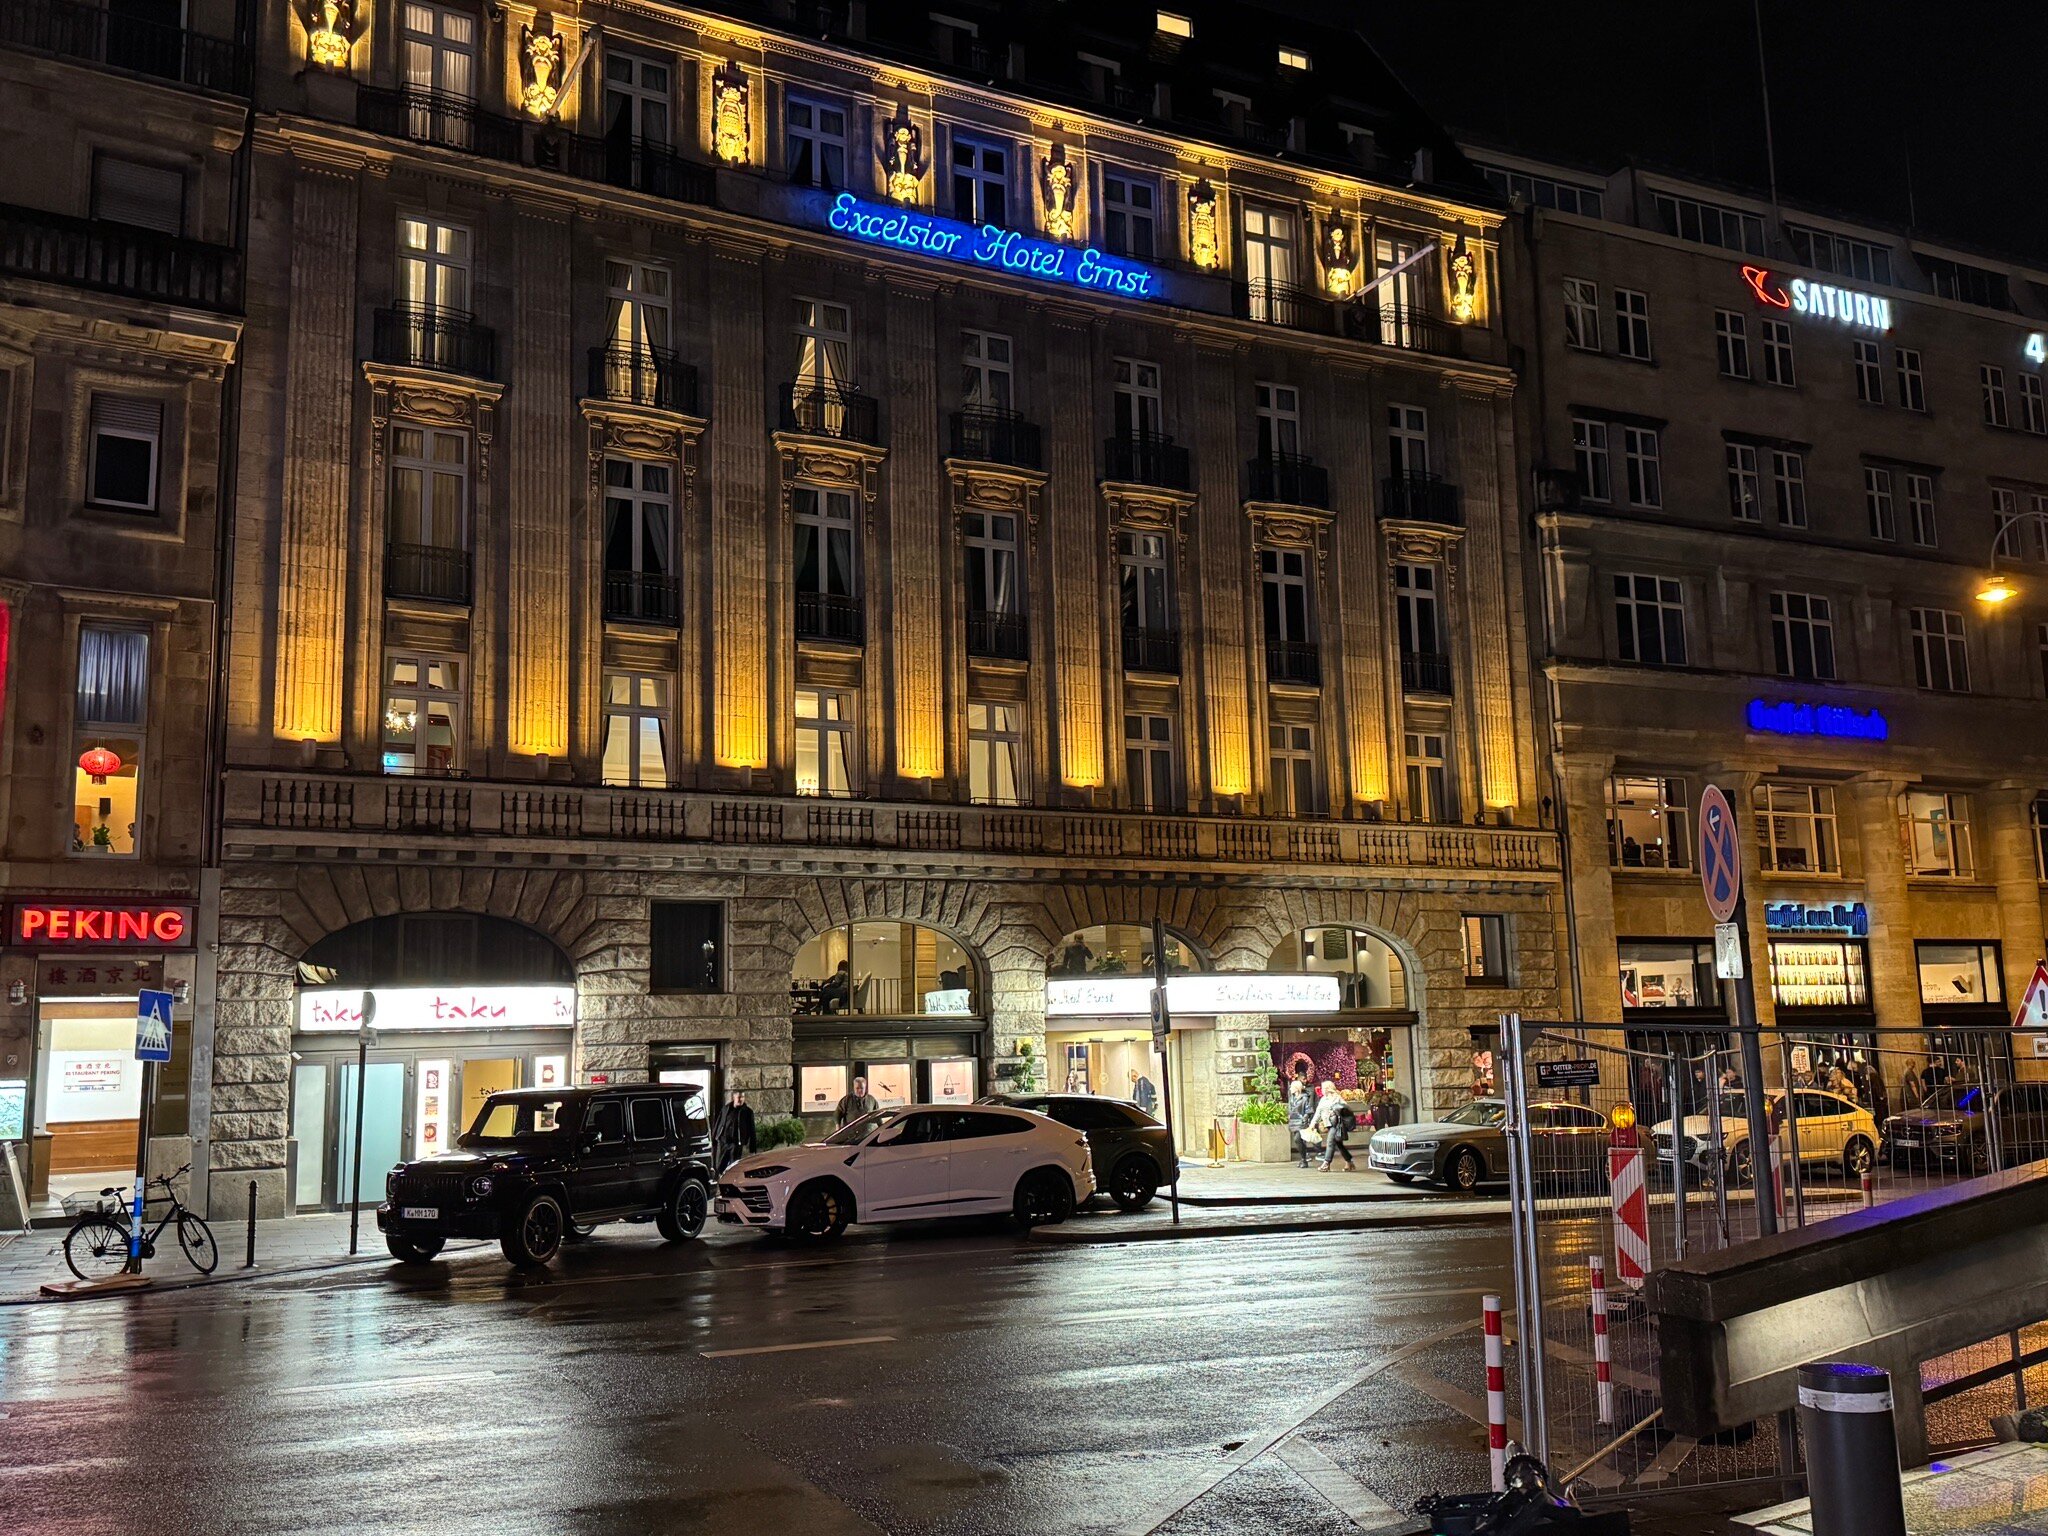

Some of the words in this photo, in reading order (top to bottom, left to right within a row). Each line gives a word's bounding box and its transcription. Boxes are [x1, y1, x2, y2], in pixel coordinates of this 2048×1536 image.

[828, 192, 962, 254] Excelsior
[973, 224, 1064, 278] Hotel
[1077, 248, 1153, 295] Ernst
[1790, 279, 1890, 330] SATURN
[2025, 332, 2046, 364] 4
[22, 908, 184, 941] PEKING
[312, 999, 364, 1023] taku
[430, 996, 507, 1020] taku
